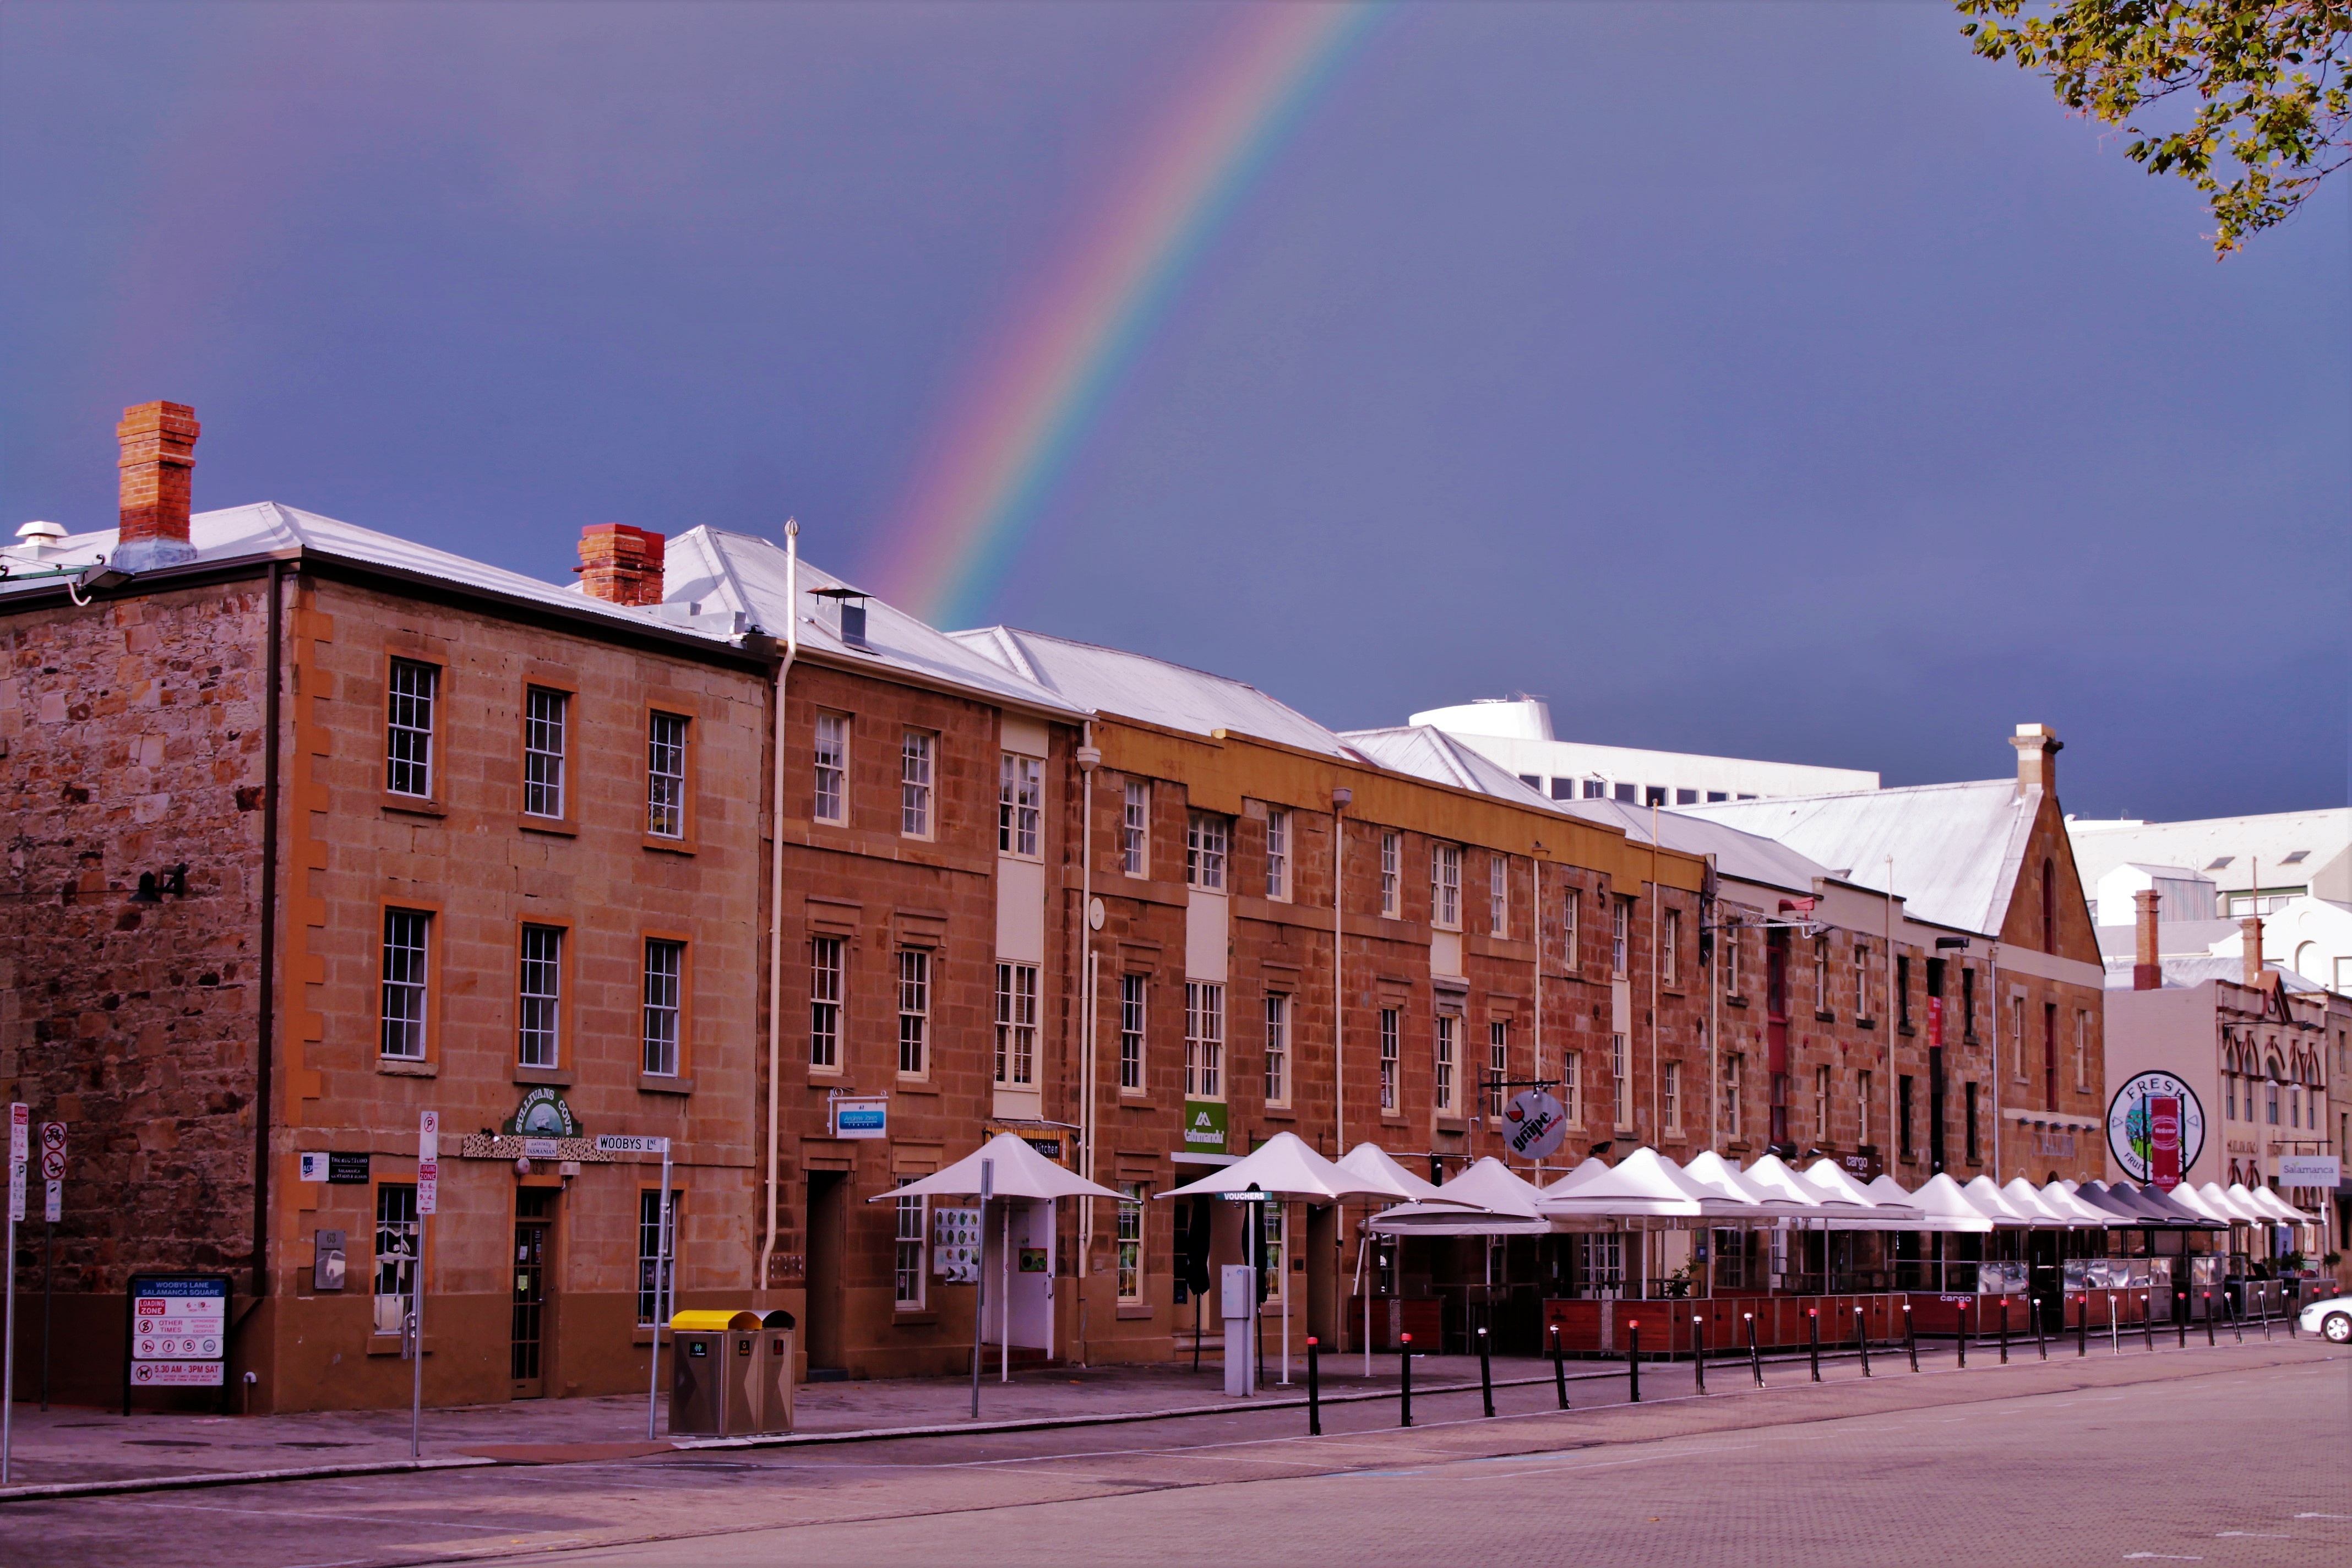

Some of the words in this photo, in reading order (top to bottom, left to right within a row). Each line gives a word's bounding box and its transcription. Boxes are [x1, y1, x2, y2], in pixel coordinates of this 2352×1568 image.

[2127, 1078, 2185, 1099] FRESH
[515, 1087, 555, 1134] SULLIVANS
[558, 1099, 572, 1135] COVE
[1512, 1112, 1551, 1152] grape
[601, 1137, 641, 1149] WOOBYS
[1036, 1142, 1058, 1154] kitchen
[1847, 1156, 1868, 1170] cargo
[2284, 1165, 2334, 1173] Salamanca
[327, 1233, 336, 1243] 63
